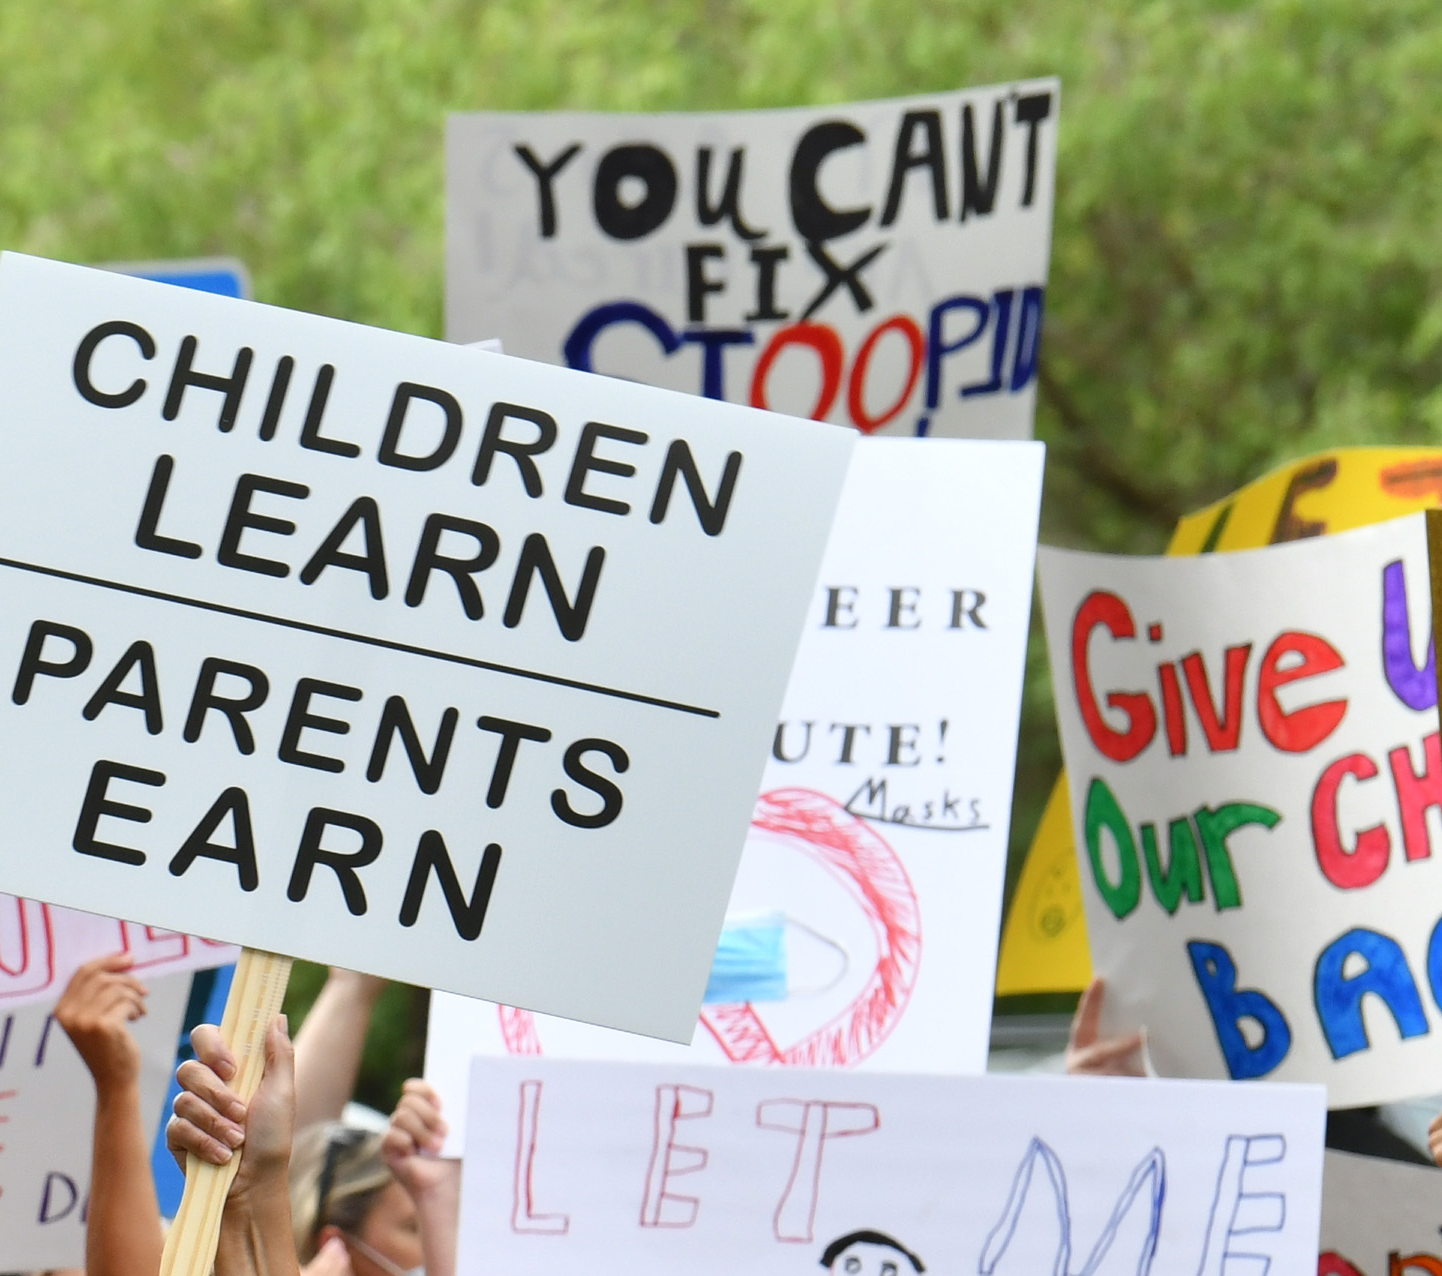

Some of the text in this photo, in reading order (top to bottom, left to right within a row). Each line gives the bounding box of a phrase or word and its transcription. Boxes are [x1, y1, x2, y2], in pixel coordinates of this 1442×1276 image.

[513, 143, 767, 240] YOU
[686, 239, 892, 326] FIX
[72, 320, 743, 538] CHILDREN
[134, 454, 606, 642] LEARN
[12, 619, 631, 831] PARENTS
[1072, 590, 1349, 763] Give
[72, 760, 503, 942] EARN
[843, 776, 984, 827] Masks
[1084, 777, 1282, 921] Our
[512, 1079, 880, 1245] LET
